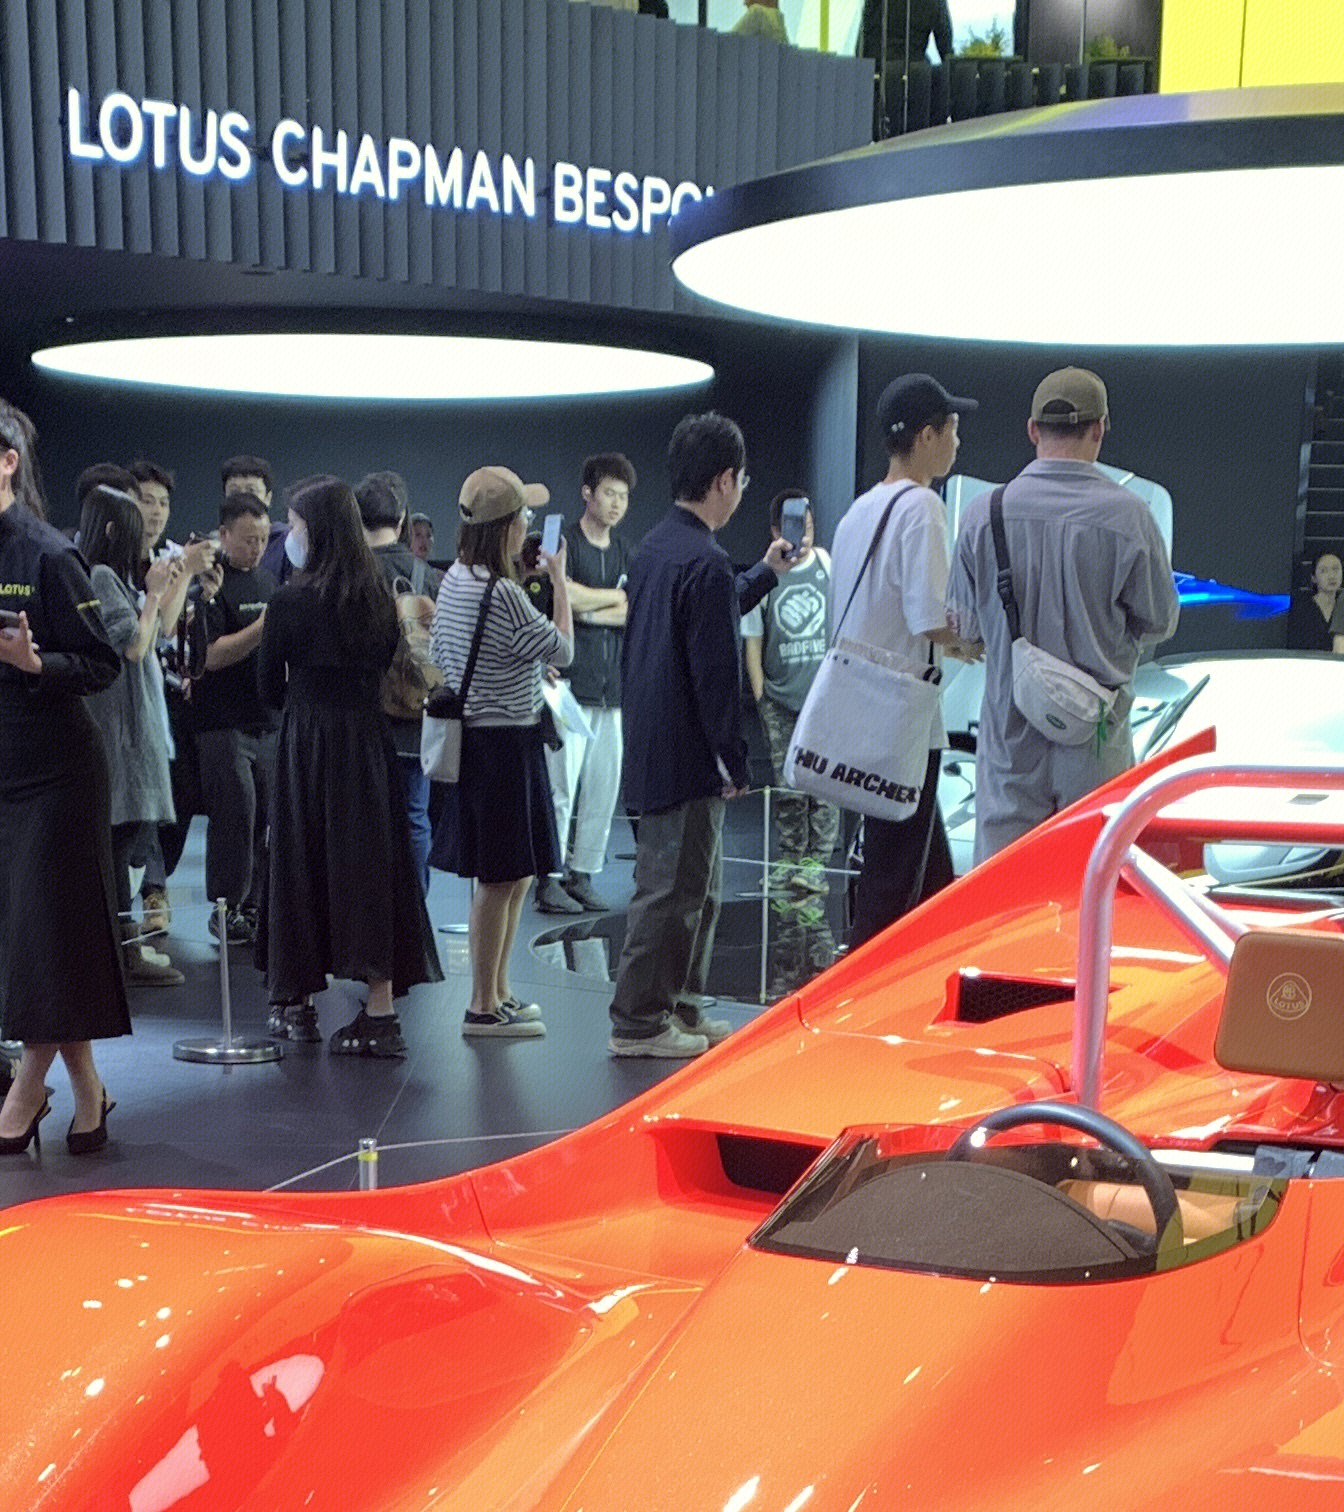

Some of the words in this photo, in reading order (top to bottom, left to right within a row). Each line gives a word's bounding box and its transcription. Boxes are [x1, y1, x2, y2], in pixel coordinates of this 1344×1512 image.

[67, 86, 251, 179] LOTUS
[271, 118, 536, 217] CHAPMAN
[554, 161, 713, 234] BESPO
[0, 583, 31, 596] LOTUS
